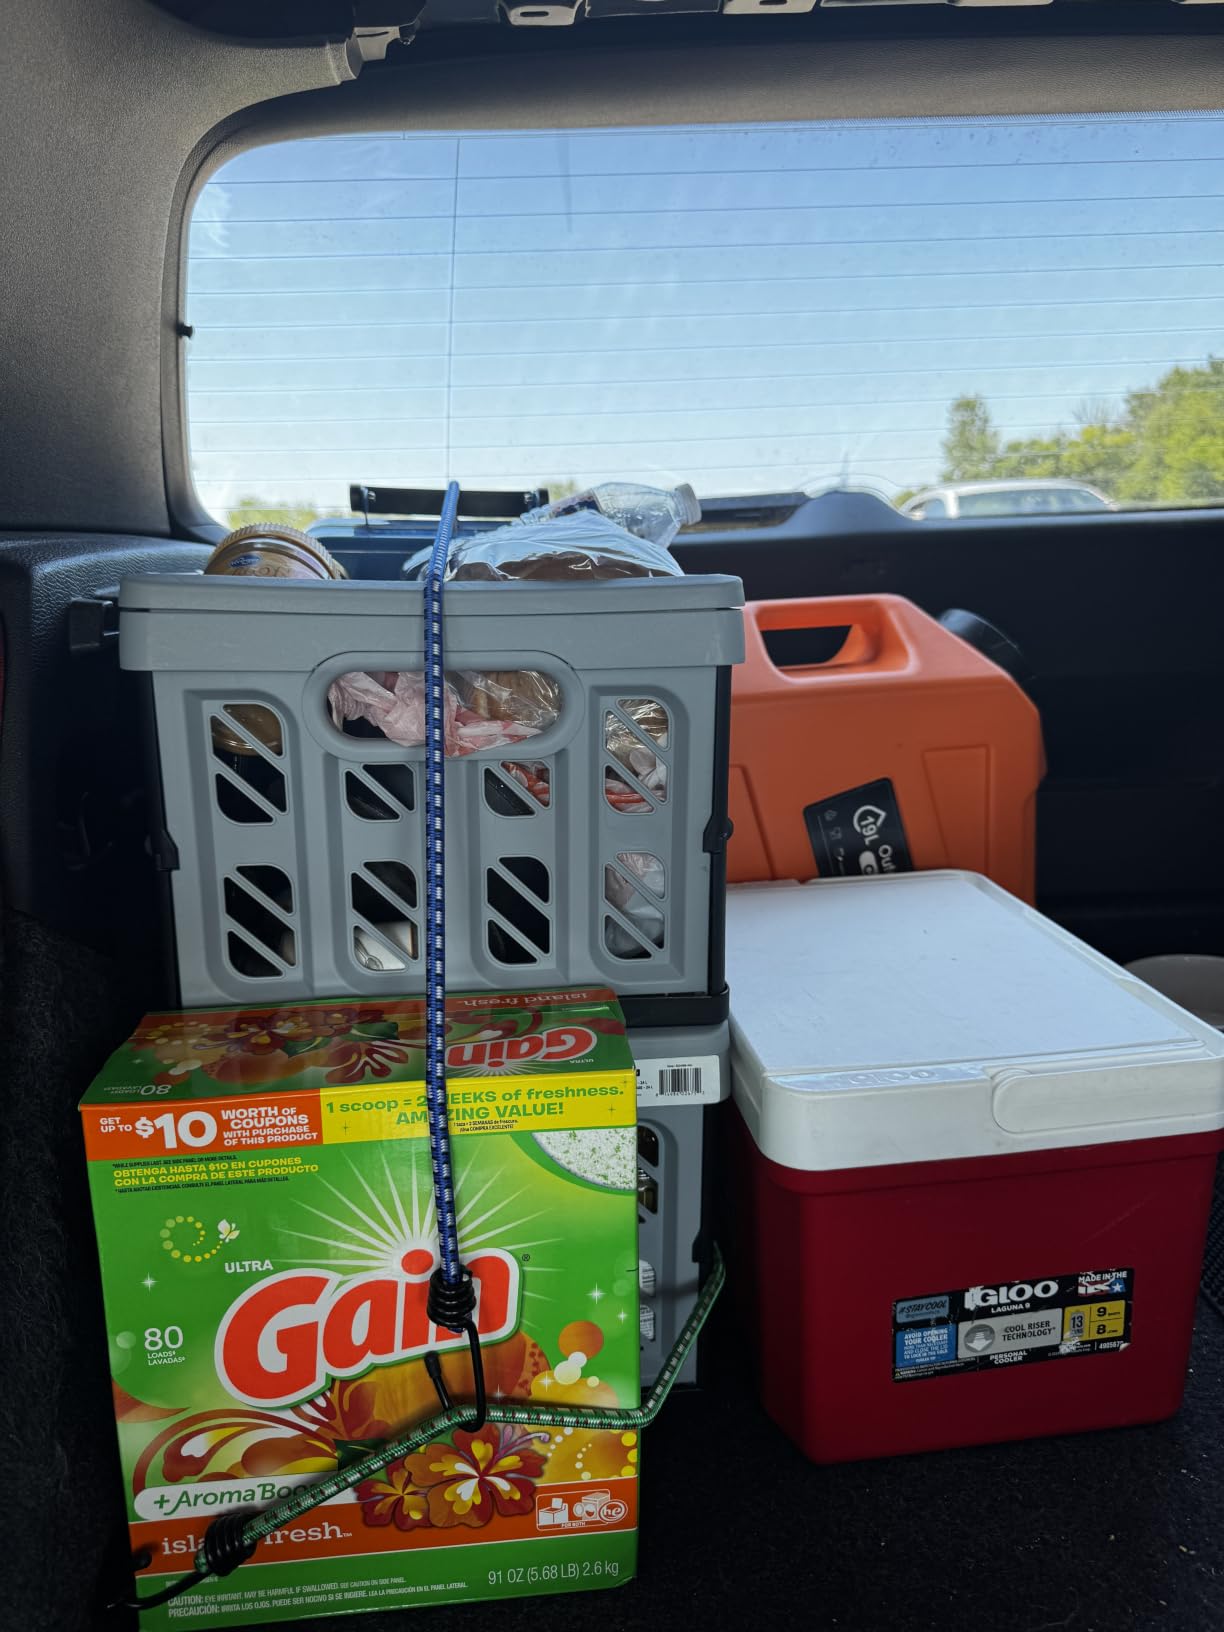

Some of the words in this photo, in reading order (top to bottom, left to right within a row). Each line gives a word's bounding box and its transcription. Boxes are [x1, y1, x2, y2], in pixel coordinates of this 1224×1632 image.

[860, 816, 879, 845] 19L
[463, 998, 518, 1007] fresh
[524, 993, 587, 1002] island
[446, 1026, 597, 1068] Gain
[140, 1085, 171, 1095] 80
[326, 1102, 334, 1113] 1
[340, 1100, 399, 1112] scoop
[417, 1095, 427, 1107] 2
[446, 1091, 497, 1104] EEKS
[502, 1089, 523, 1101] of
[527, 1086, 624, 1100] freshness.
[221, 1106, 279, 1120] WORTH
[281, 1107, 297, 1115] OF
[396, 1106, 490, 1125] AMZING
[495, 1102, 564, 1118] VALUE!
[100, 1117, 121, 1125] GET
[230, 1114, 309, 1129] COUPONS
[100, 1125, 116, 1133] UP
[118, 1124, 133, 1132] TO
[135, 1110, 218, 1149] $10
[223, 1130, 250, 1138] WITH
[252, 1125, 310, 1136] PURCHASE
[240, 1137, 265, 1145] THIS
[267, 1132, 318, 1143] PRODUCT
[113, 1167, 168, 1178] OBTENGA
[169, 1164, 206, 1174] HASTA
[208, 1162, 229, 1171] $10
[231, 1161, 245, 1169] EN
[248, 1157, 302, 1167] CUPONES
[115, 1178, 139, 1186] CON
[159, 1173, 208, 1183] COMPRA
[211, 1171, 225, 1179] DE
[228, 1169, 256, 1178] ESTE
[258, 1164, 319, 1176] PRODUCTO
[224, 1259, 273, 1273] ULTRA
[991, 1304, 1024, 1313] LAGUNA
[1097, 1307, 1107, 1317] 9
[216, 1247, 519, 1406] Gain
[1004, 1325, 1026, 1333] COOL
[1027, 1320, 1050, 1330] RISER
[1071, 1315, 1083, 1329] 13
[904, 1332, 922, 1340] AVOID
[1096, 1324, 1106, 1335] 8
[144, 1325, 184, 1351] 80
[904, 1338, 922, 1346] YOUR
[923, 1334, 948, 1343] COOLER
[989, 1350, 1028, 1361] PERSONAL
[994, 1356, 1023, 1365] COOLER
[602, 1503, 622, 1518] he
[488, 1571, 502, 1585] 91
[507, 1569, 525, 1583] OZ
[527, 1565, 558, 1584] (5.68
[561, 1563, 580, 1579] LB)
[582, 1561, 601, 1576] 2.6
[605, 1560, 619, 1576] kg
[168, 1595, 203, 1606] CAUTION:
[205, 1595, 216, 1603] EYE
[258, 1590, 266, 1598] BE
[267, 1587, 294, 1596] HARMFUL
[168, 1604, 220, 1618] PRECAUCIÓN:
[241, 1602, 253, 1610] LOS
[272, 1598, 291, 1607] PUEDE
